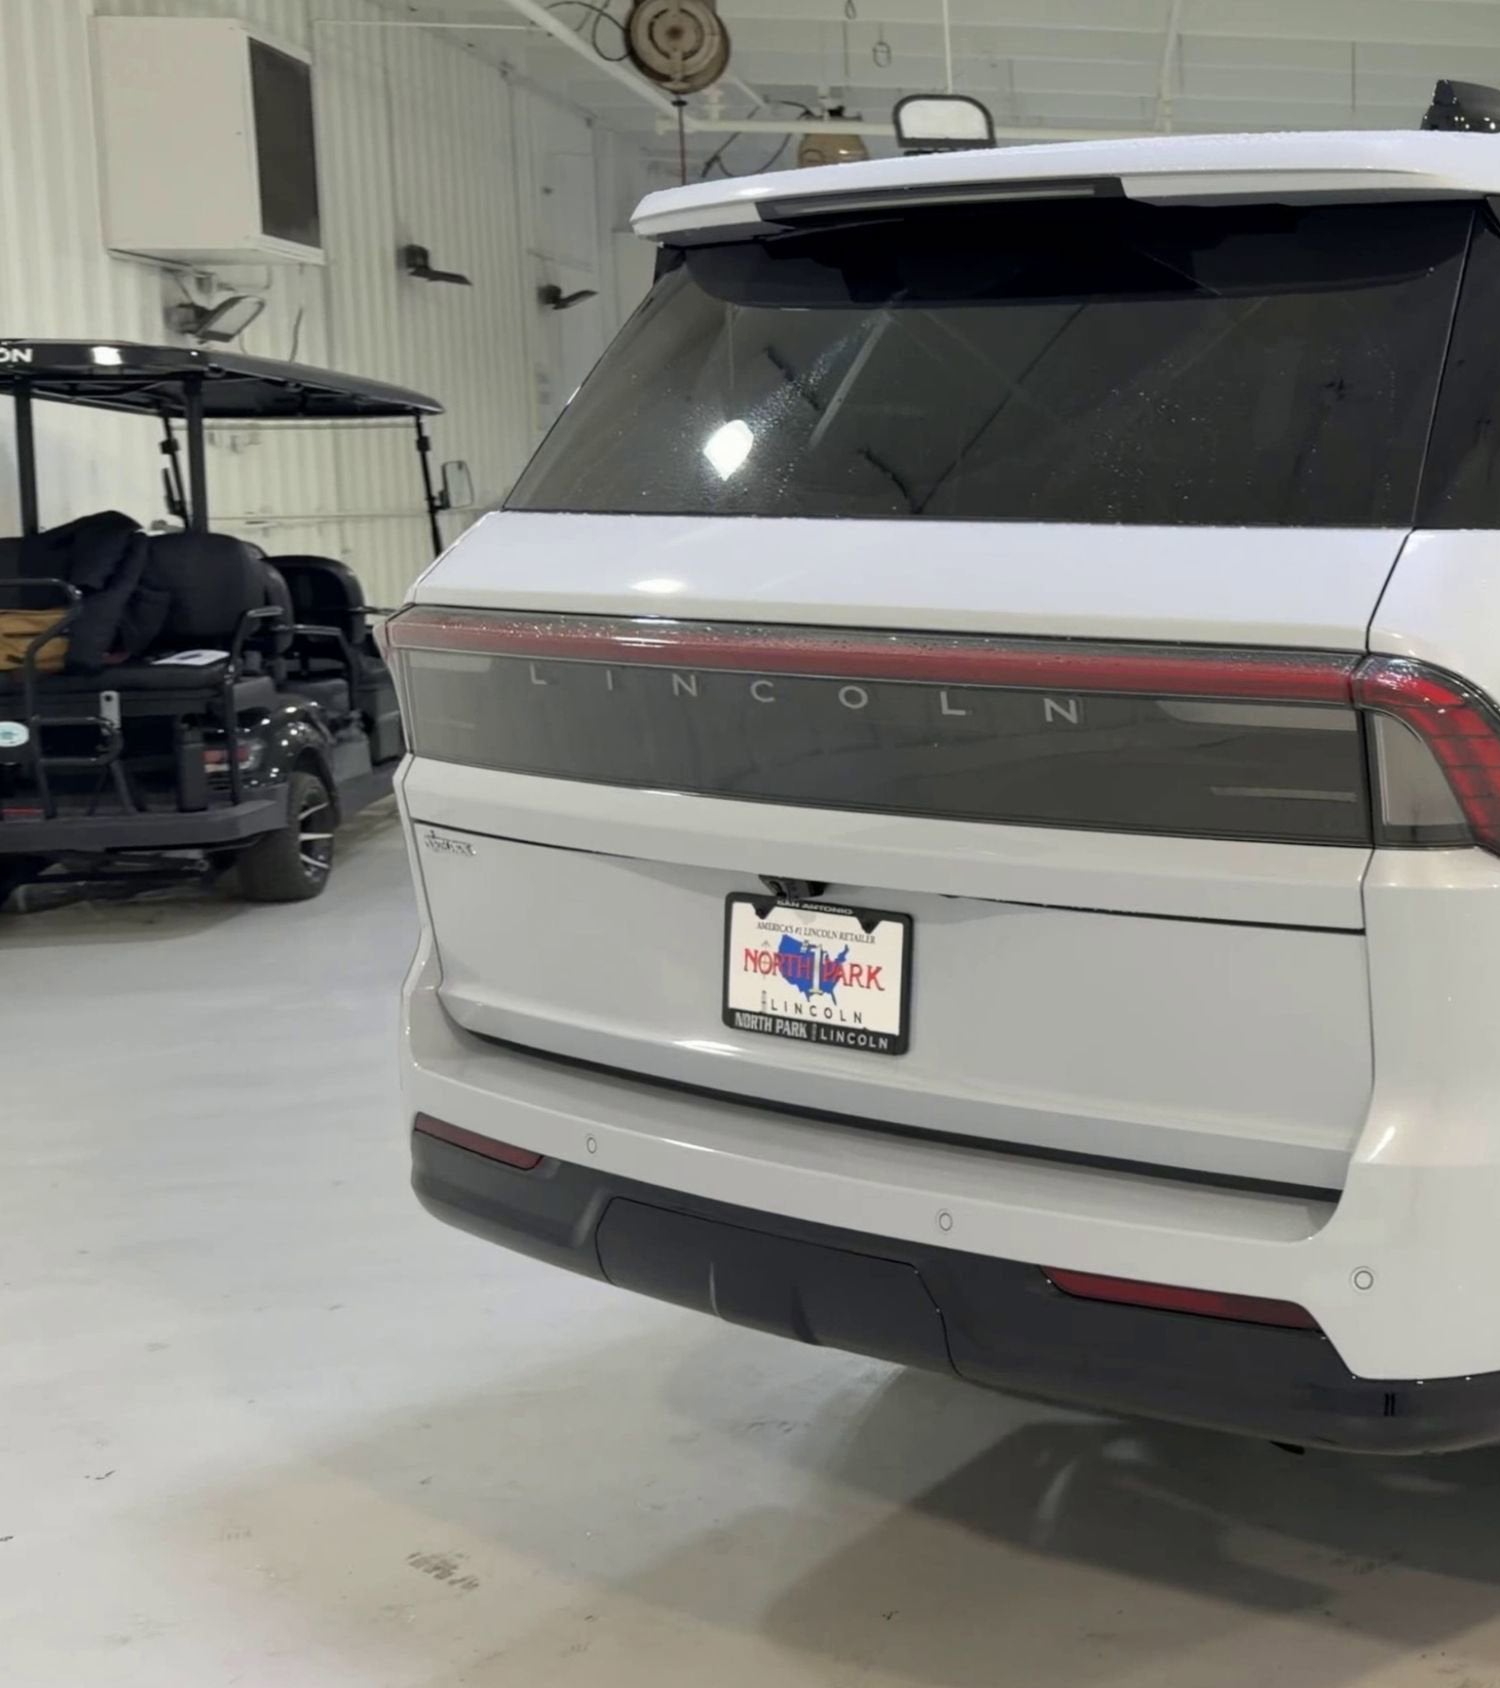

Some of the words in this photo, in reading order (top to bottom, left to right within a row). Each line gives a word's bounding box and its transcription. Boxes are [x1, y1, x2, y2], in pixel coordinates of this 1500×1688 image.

[529, 663, 1080, 723] LINCOLN
[802, 904, 853, 915] ANTONIO
[804, 928, 837, 940] LINCOLN
[839, 932, 876, 944] RETAILER
[743, 948, 811, 980] NORTH
[823, 957, 885, 991] PARK
[771, 999, 863, 1024] LINCOLN
[734, 1013, 772, 1032] NORTH
[776, 1018, 808, 1039] PARK
[820, 1028, 888, 1049] LINCOLN
